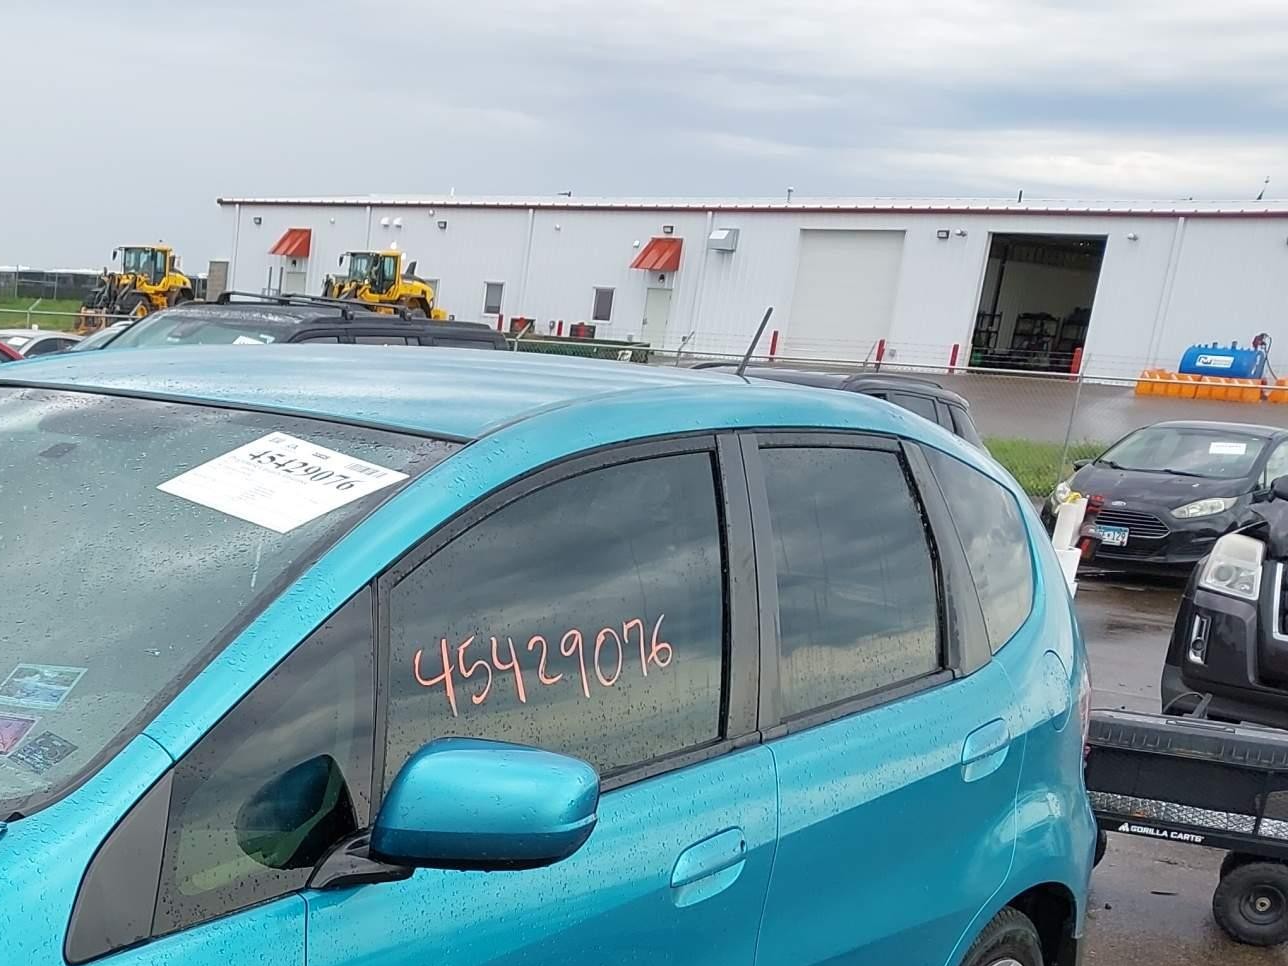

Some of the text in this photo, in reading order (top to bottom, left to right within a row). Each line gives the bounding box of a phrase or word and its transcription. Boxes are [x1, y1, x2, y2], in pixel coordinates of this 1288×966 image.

[248, 449, 360, 492] 45429076
[414, 613, 673, 718] 45429076
[1130, 825, 1203, 843] GORILLA CARTS
